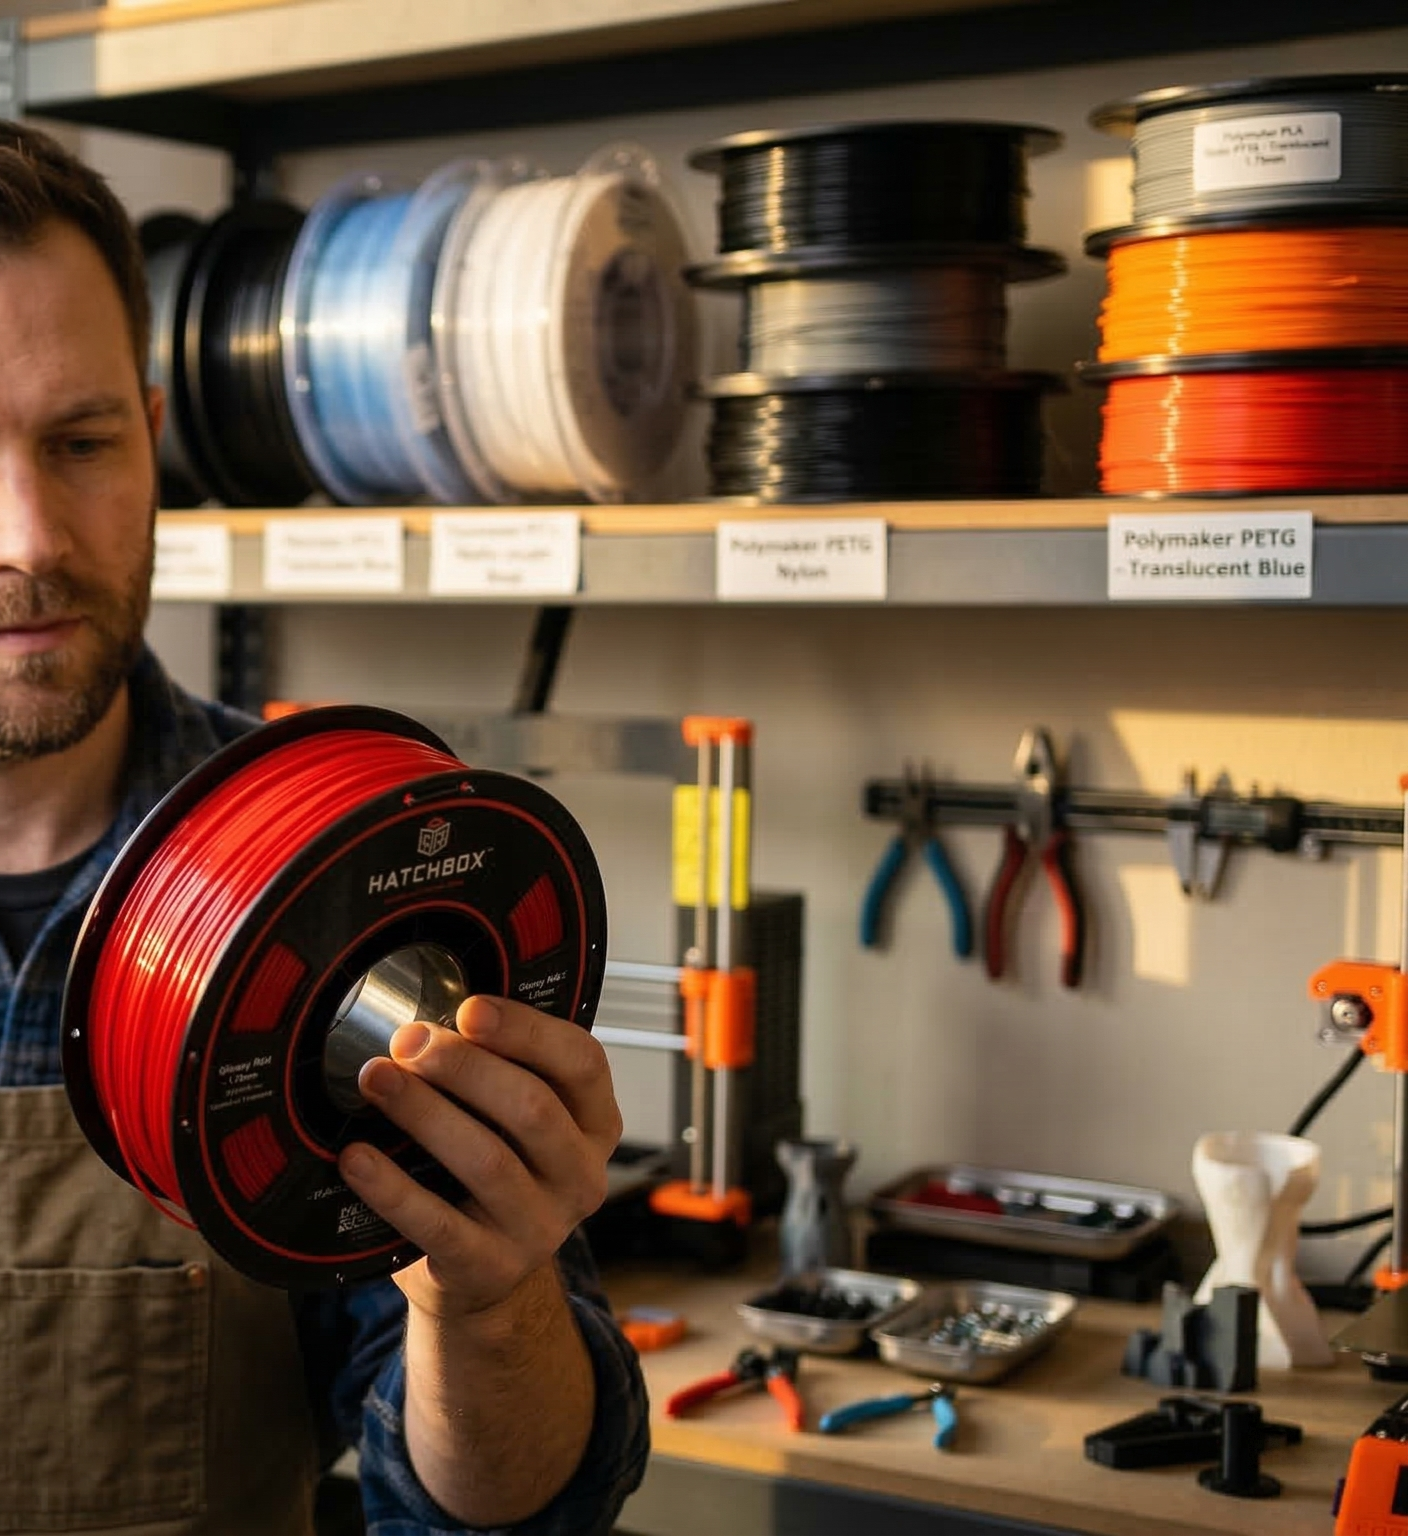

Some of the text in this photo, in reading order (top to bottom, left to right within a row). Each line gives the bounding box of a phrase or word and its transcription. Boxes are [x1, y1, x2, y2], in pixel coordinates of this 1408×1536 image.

[1281, 125, 1303, 137] PLA
[826, 534, 873, 552] PETG
[1125, 528, 1296, 551] Polymaker PETG
[1130, 559, 1252, 577] Translucent
[1258, 558, 1306, 576] Blue
[368, 850, 487, 895] HATCHBOX
